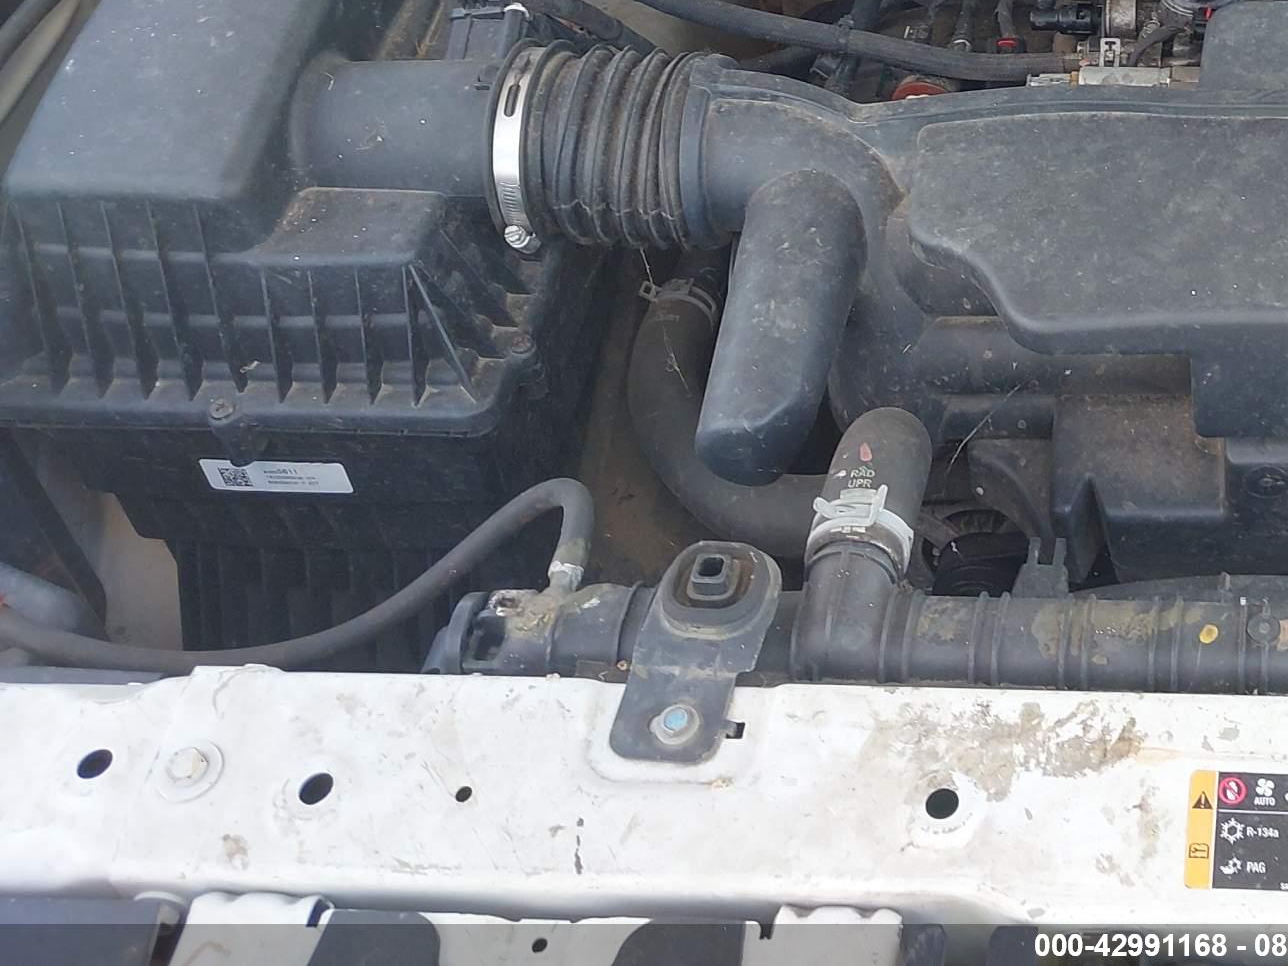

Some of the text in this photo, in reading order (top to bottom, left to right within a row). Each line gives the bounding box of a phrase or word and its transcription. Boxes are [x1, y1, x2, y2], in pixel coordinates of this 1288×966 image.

[850, 469, 876, 478] RAD
[847, 478, 873, 488] UPR
[1253, 796, 1276, 806] AUTO
[1246, 826, 1280, 838] R-134a
[1246, 861, 1266, 874] PAG
